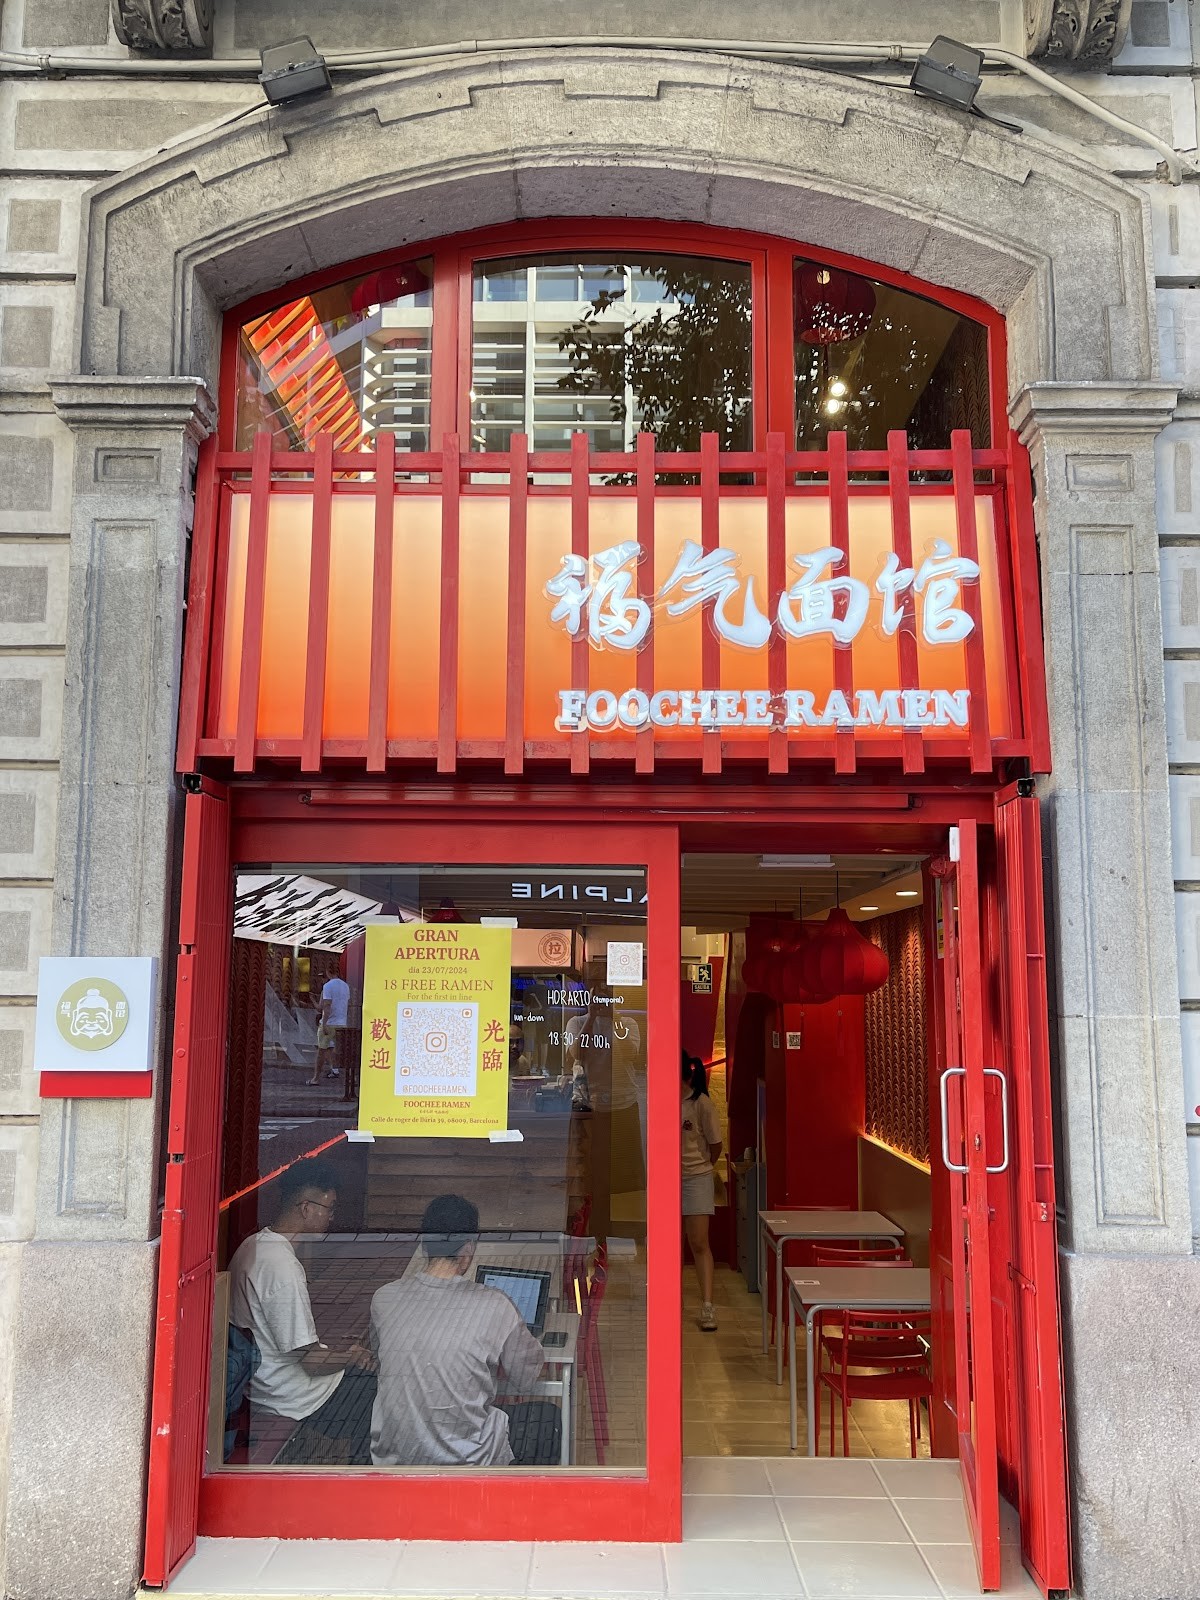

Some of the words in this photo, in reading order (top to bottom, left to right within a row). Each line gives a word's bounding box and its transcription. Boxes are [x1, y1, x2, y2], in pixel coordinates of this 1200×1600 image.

[546, 539, 980, 649] 福气面馆
[557, 689, 772, 727] FOOCHEE
[784, 689, 970, 726] RAMEN
[414, 929, 459, 942] GRAN
[394, 947, 480, 960] APERTURA
[422, 966, 468, 974] 23/07/2024
[384, 979, 397, 991] 18
[402, 979, 437, 991] FREE
[441, 979, 494, 991] RAMEN
[449, 993, 456, 1001] in
[457, 993, 473, 1001] line
[547, 990, 591, 1006] HORARIO
[402, 1085, 468, 1093] @FOOCHEERAMEN
[442, 1101, 471, 1109] RAMEN
